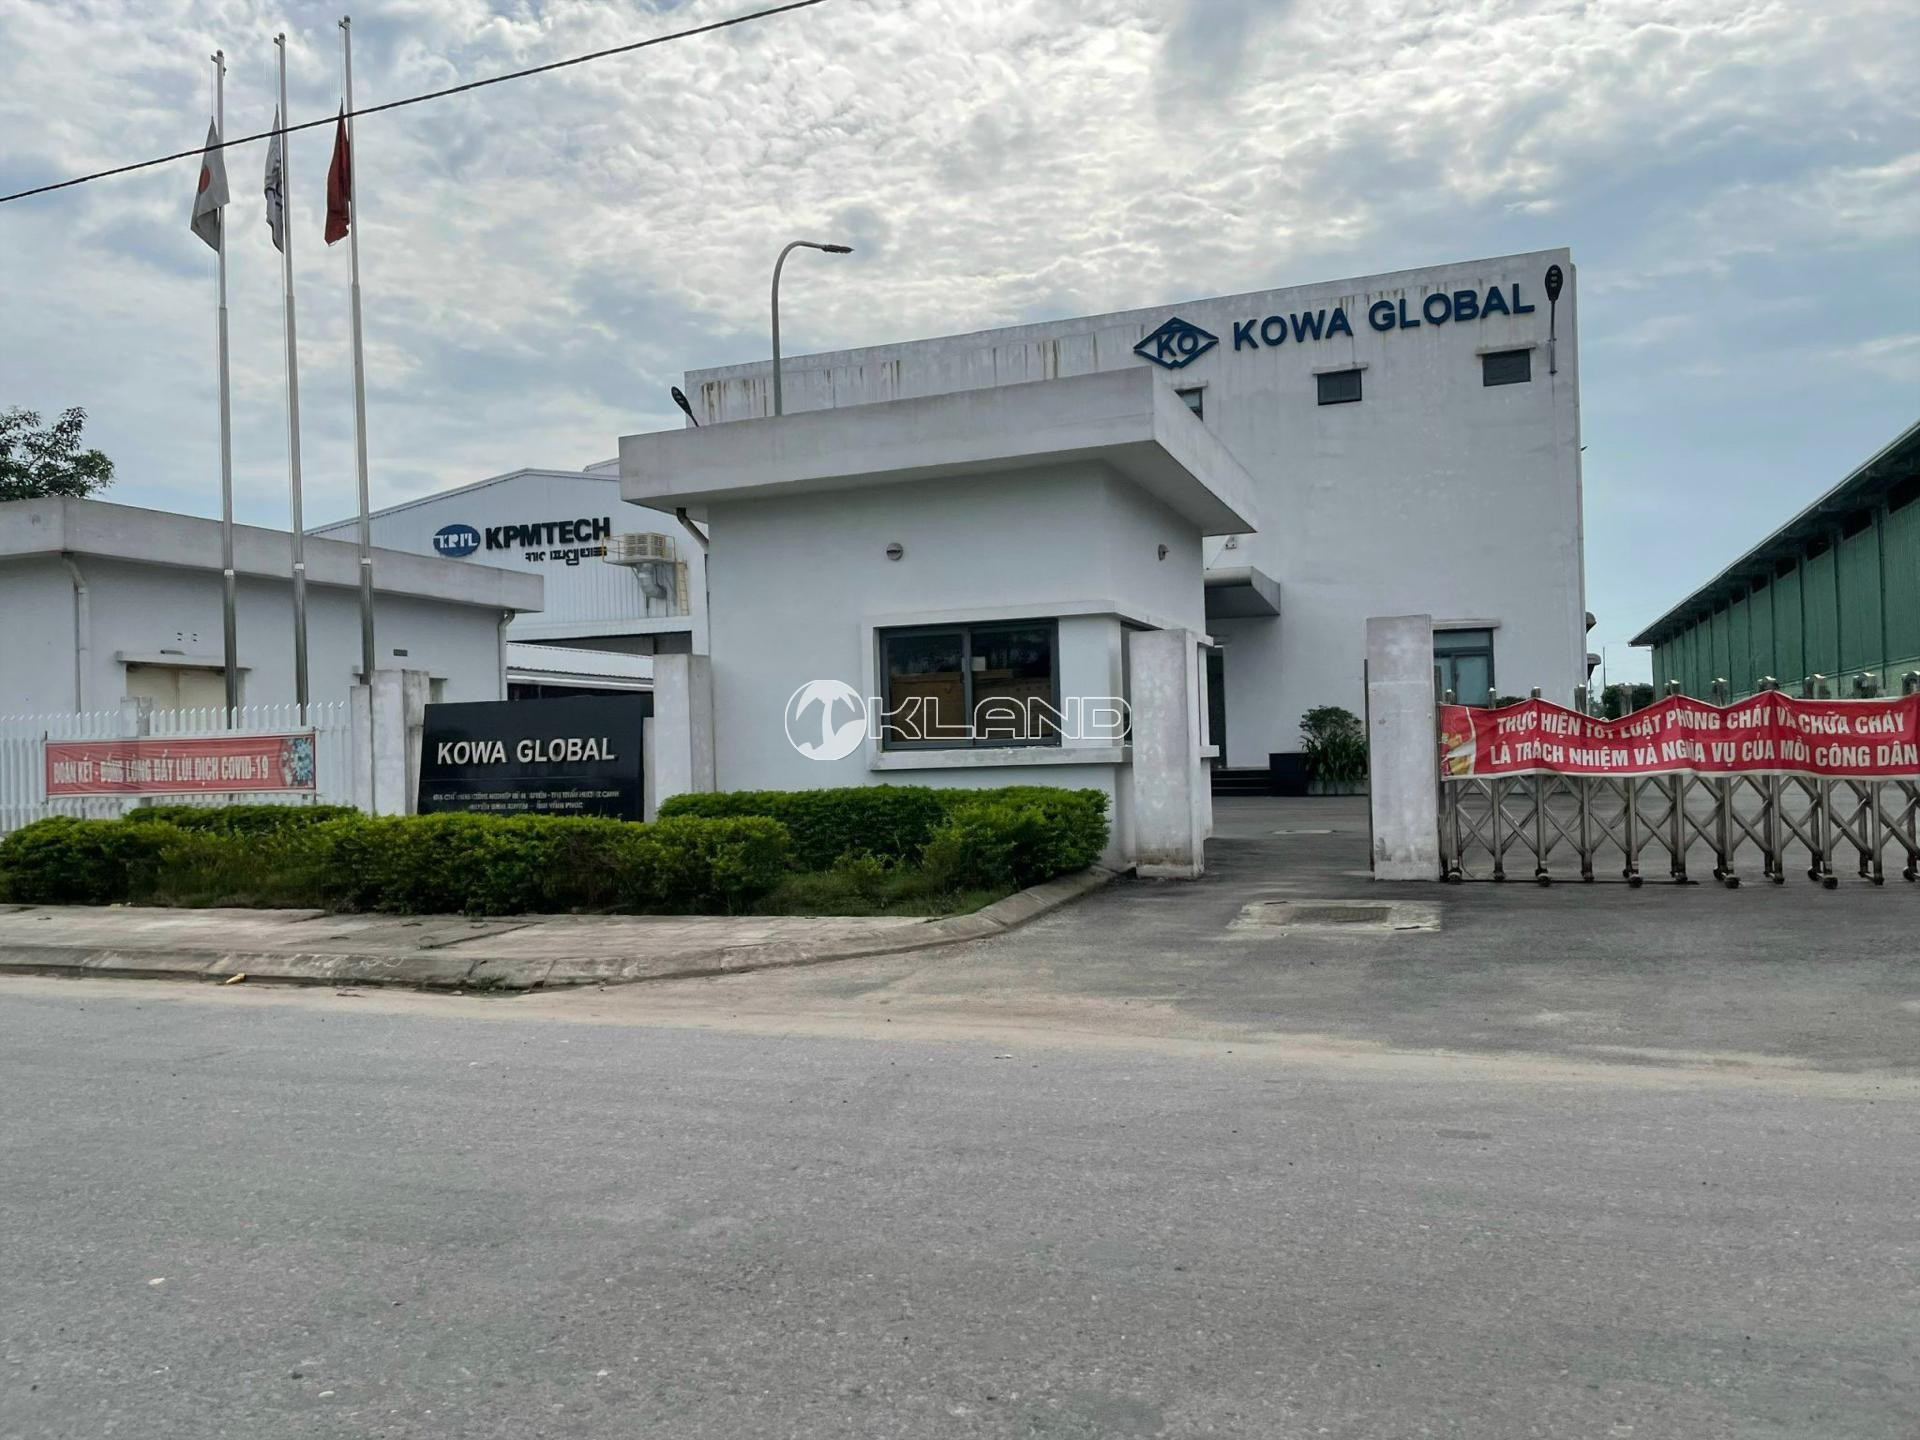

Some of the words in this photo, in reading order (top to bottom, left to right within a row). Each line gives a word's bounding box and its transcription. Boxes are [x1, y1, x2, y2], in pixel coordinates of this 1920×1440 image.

[1233, 308, 1354, 351] KOWA
[1368, 282, 1536, 333] GLOBAL
[485, 517, 611, 550] KPMTECH
[1496, 710, 1538, 736] THỰC
[1541, 711, 1580, 739] HIỆN
[1620, 714, 1661, 740] LUẬT
[1666, 705, 1720, 730] PHÒNG
[1726, 703, 1771, 729] CHÁY
[1798, 710, 1851, 734] CHỮA
[1854, 709, 1905, 734] CHÁY
[221, 755, 269, 780] COVID-19
[437, 741, 508, 765] KOWA
[516, 737, 616, 763] GLOBAL
[1490, 740, 1512, 765] LÀ
[1515, 737, 1564, 763] TRÁCH
[1569, 745, 1629, 770] NHIỆM
[1633, 742, 1659, 766] VÀ
[1711, 742, 1736, 767] VỤ
[1741, 731, 1775, 762] CỦA
[1815, 742, 1871, 767] CÔNG
[1876, 740, 1919, 767] DÂN
